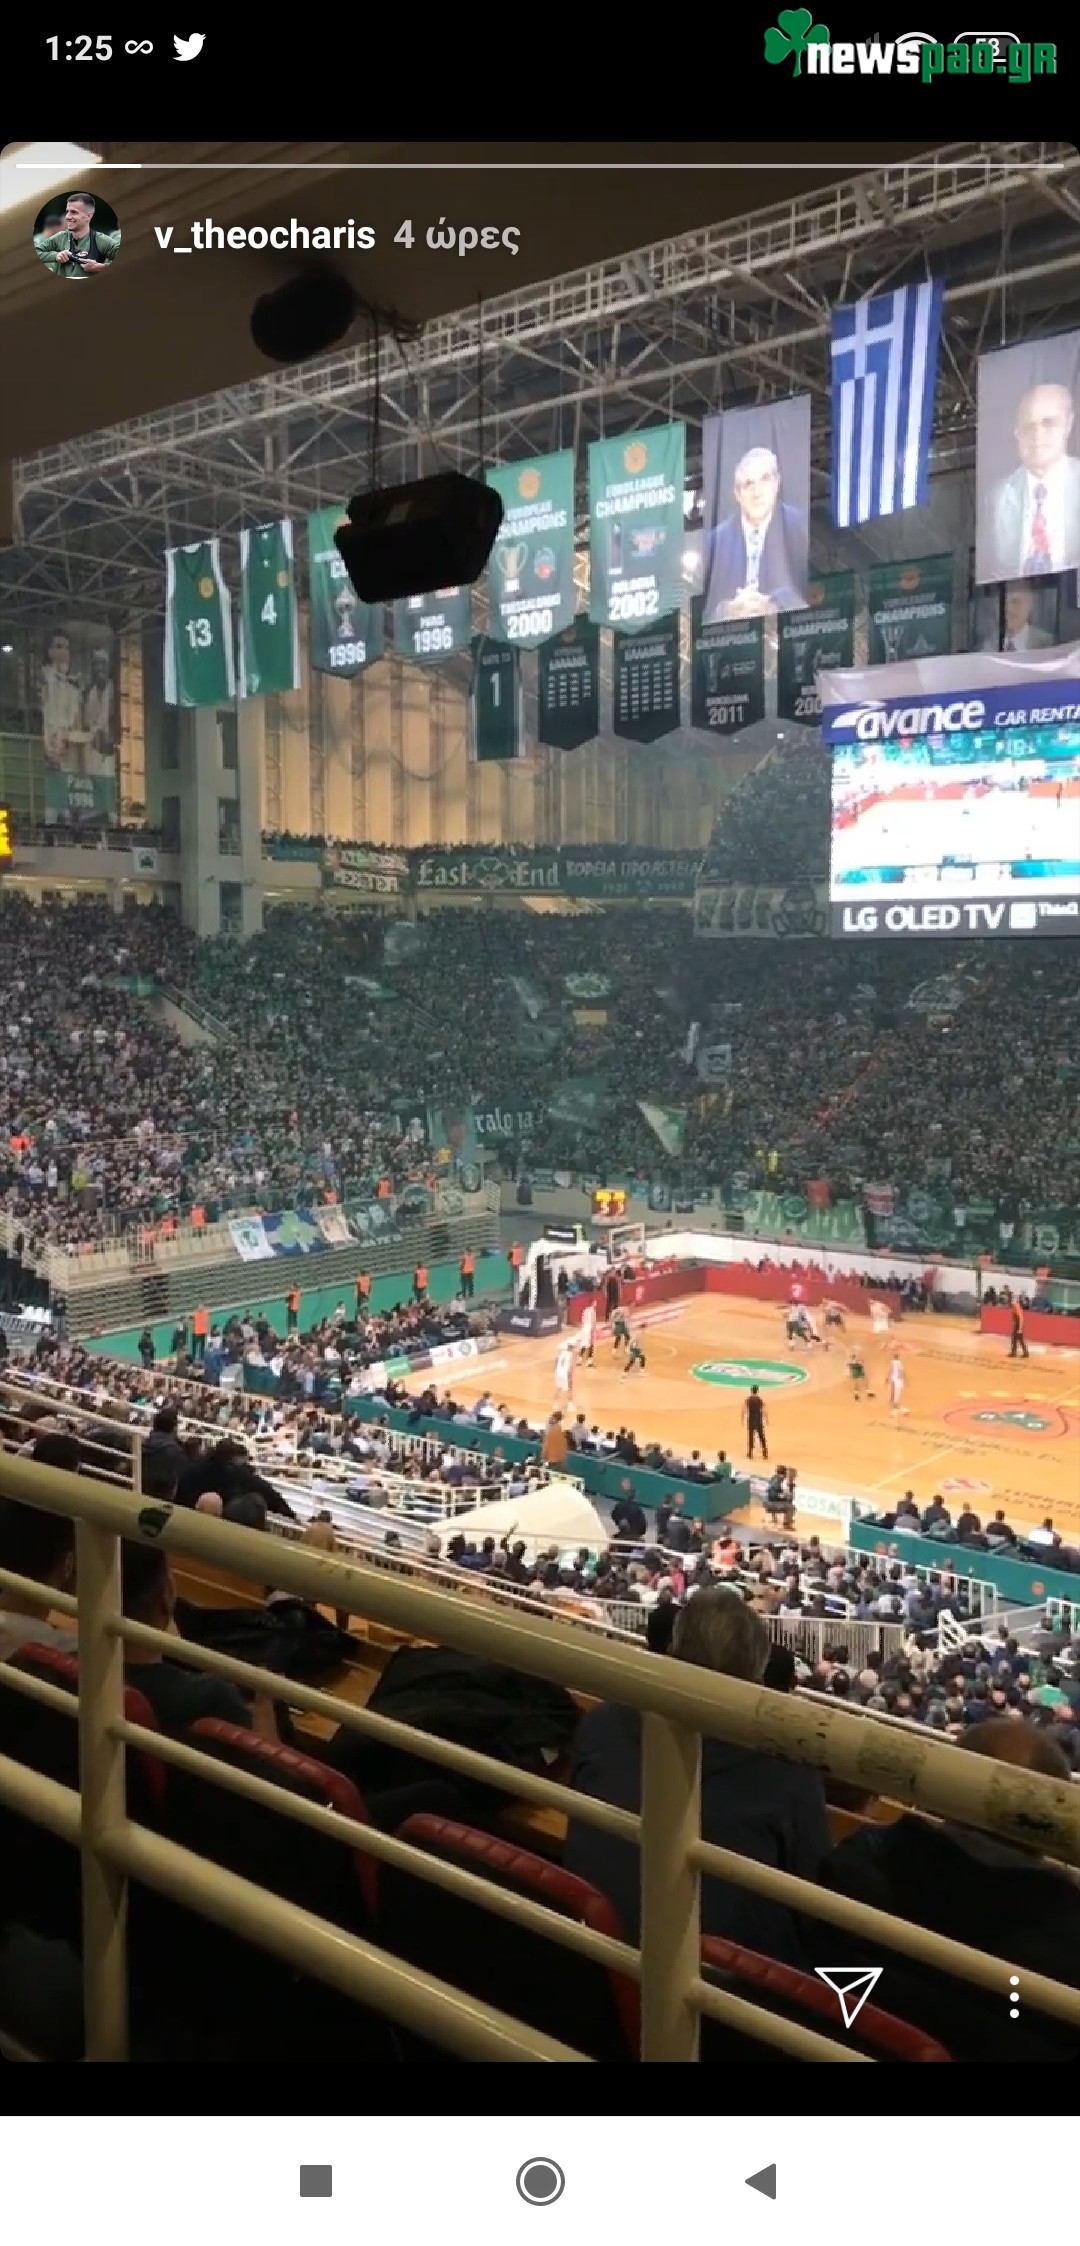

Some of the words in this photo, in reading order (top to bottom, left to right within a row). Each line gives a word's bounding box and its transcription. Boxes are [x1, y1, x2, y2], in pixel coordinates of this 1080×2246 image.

[595, 485, 677, 519] CHAMPIONS
[260, 591, 278, 626] 4
[608, 590, 660, 622] 2002
[873, 602, 947, 625] CHAMPIONS
[185, 617, 214, 649] 13
[412, 626, 454, 654] 1996
[506, 609, 553, 640] 2000
[327, 640, 367, 668] 1996
[489, 671, 500, 708] 1
[707, 704, 746, 726] 2011
[857, 699, 986, 739] avance
[994, 709, 1026, 726] CAR
[416, 857, 469, 886] East
[843, 907, 878, 931] LG
[885, 905, 960, 930] OLED
[962, 903, 1005, 929] TV
